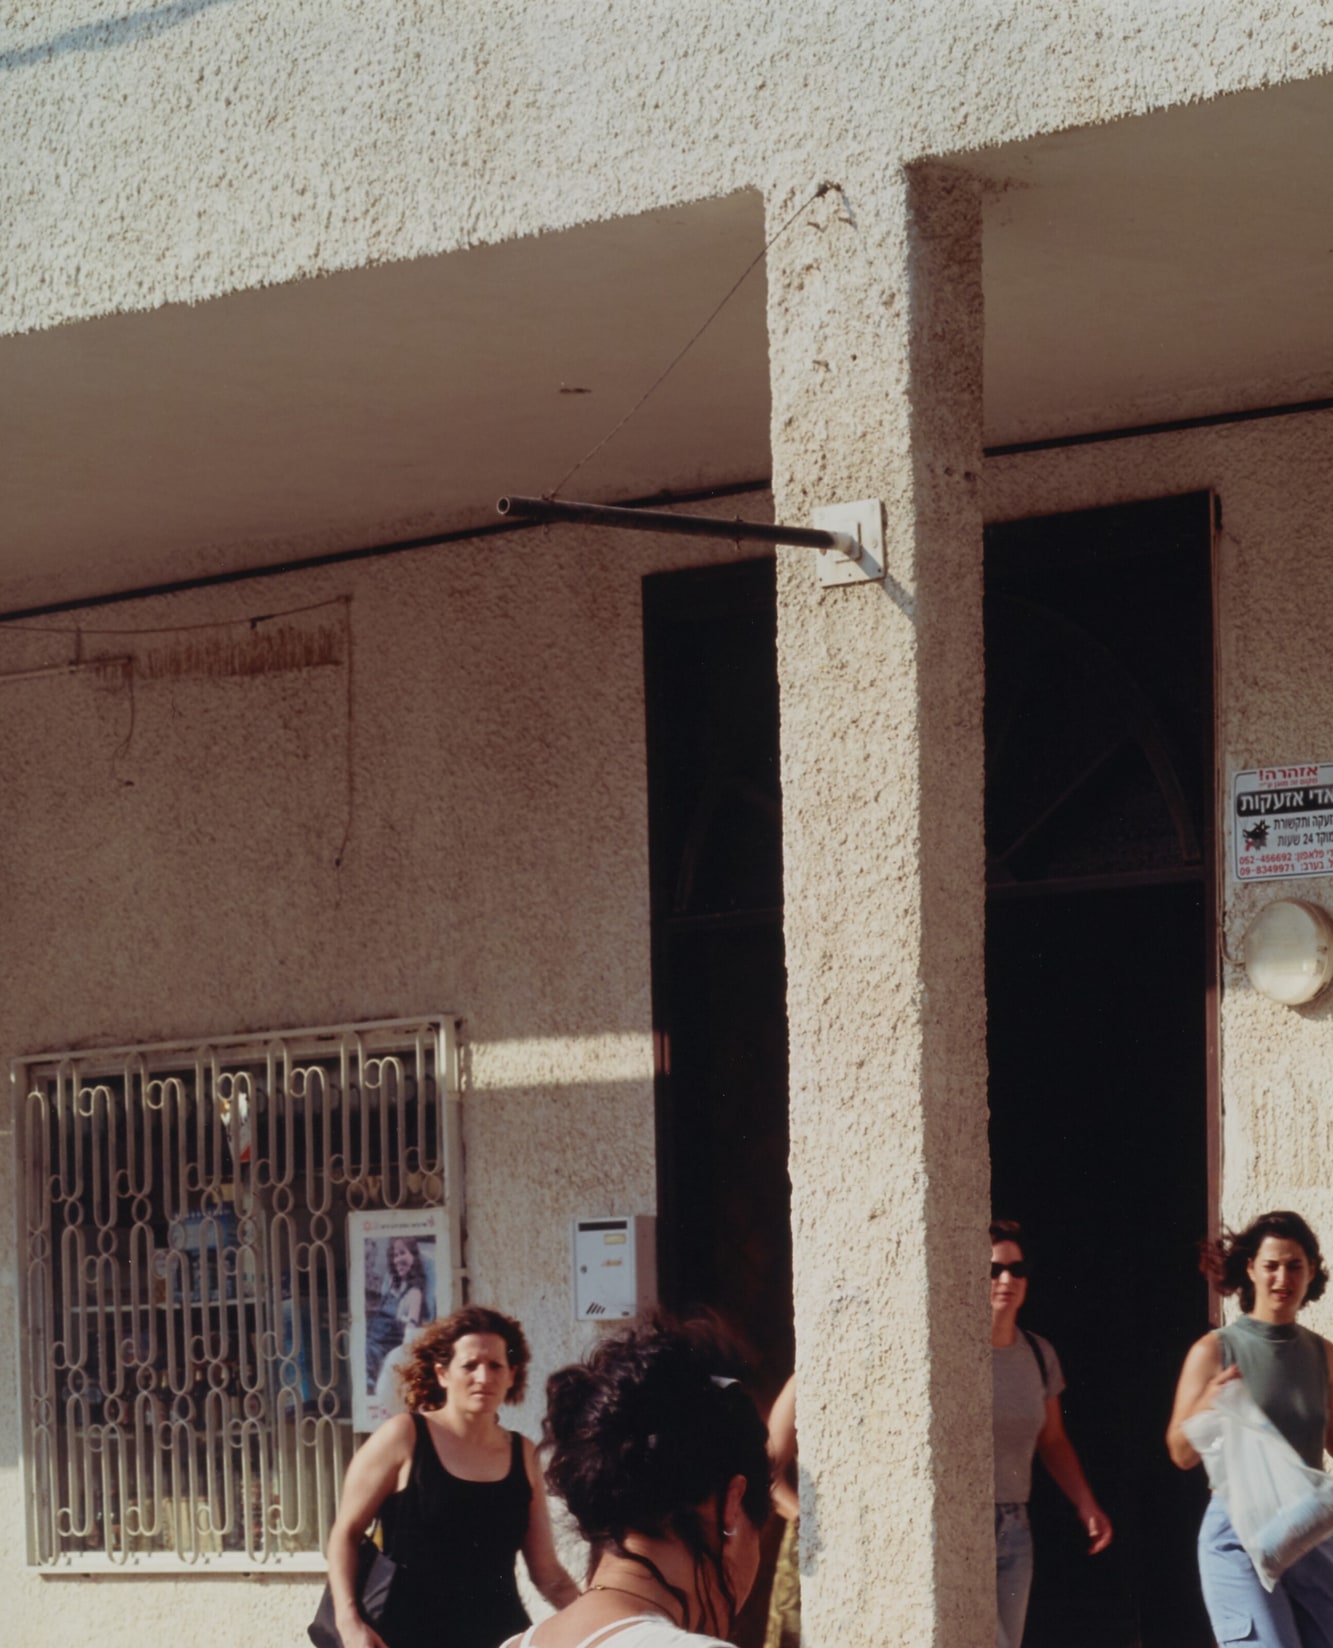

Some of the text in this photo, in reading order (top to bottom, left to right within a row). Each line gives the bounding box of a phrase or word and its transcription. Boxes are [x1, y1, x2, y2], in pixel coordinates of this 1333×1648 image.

[1259, 766, 1318, 781] אזהרה!
[1241, 791, 1304, 813] אזעקות
[1273, 816, 1310, 832] ותקשורת
[1277, 834, 1301, 847] שעות
[1303, 832, 1314, 845] 24
